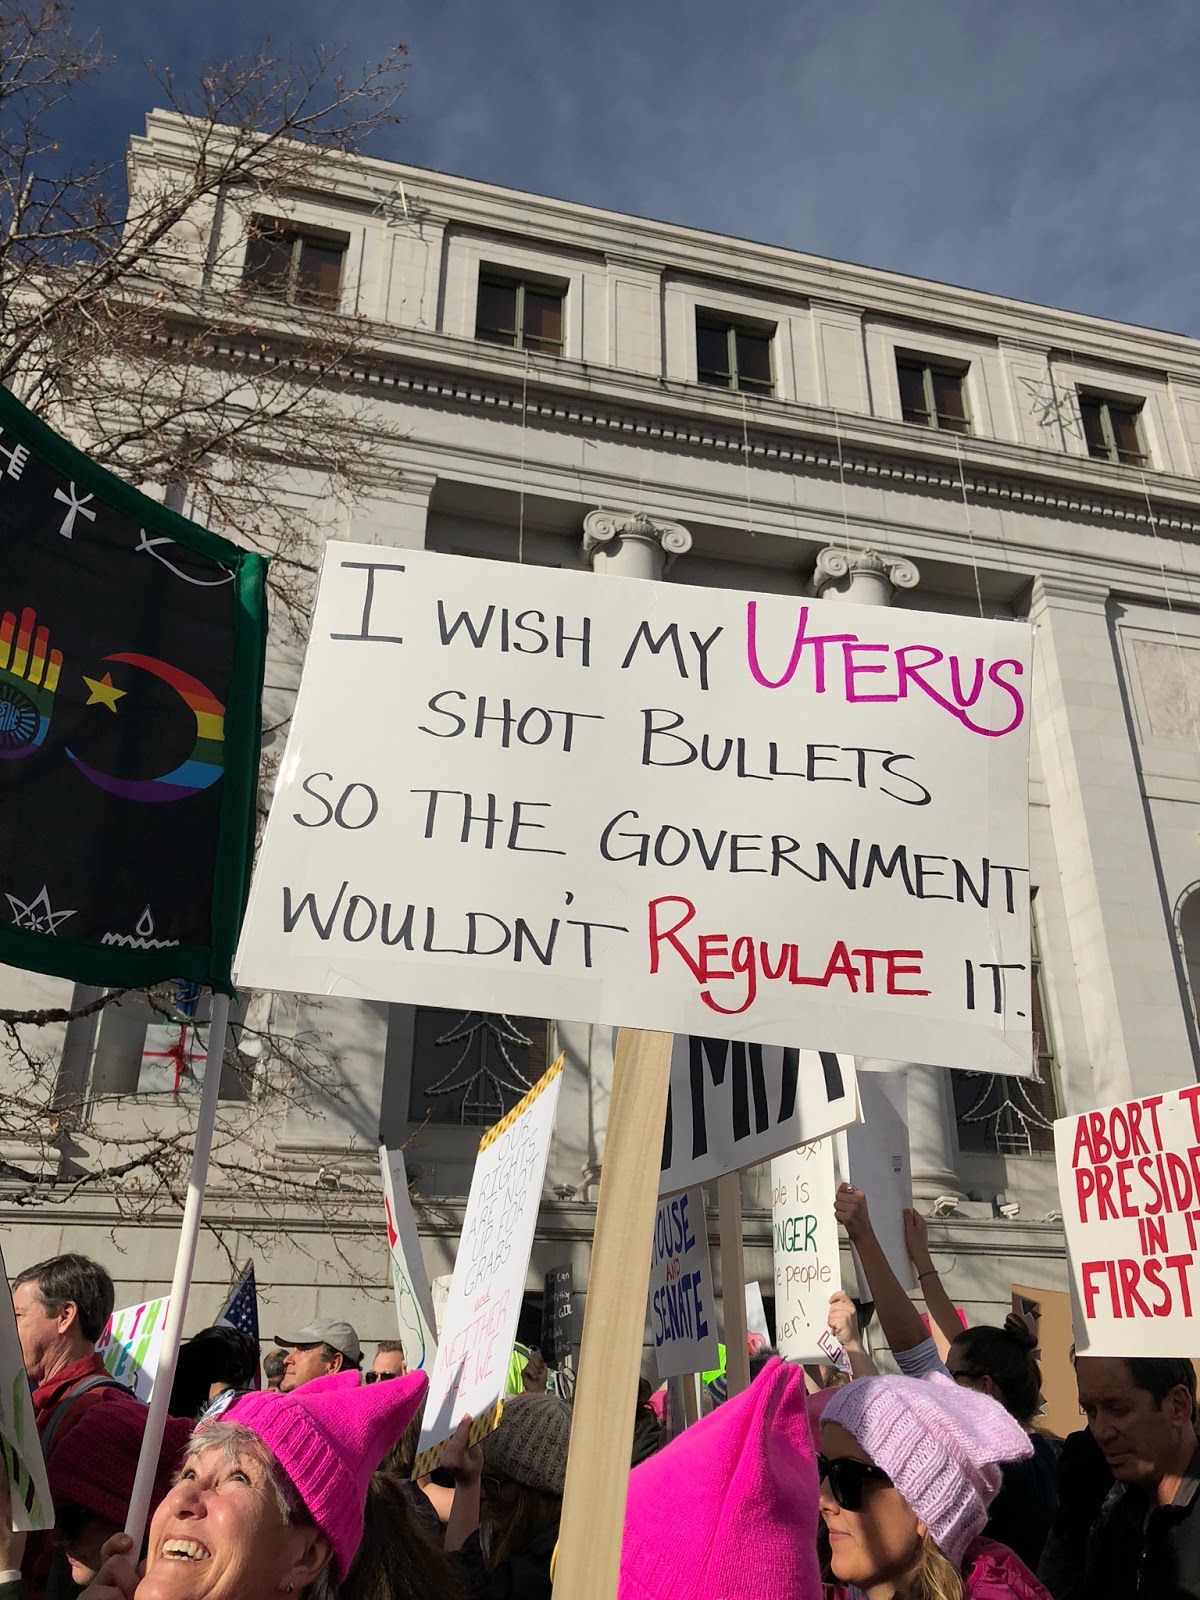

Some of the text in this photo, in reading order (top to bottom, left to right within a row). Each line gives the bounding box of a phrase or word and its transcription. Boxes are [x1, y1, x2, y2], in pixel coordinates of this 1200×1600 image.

[330, 561, 1025, 737] I WISH MY UTERUS
[418, 690, 932, 805] SHOT BULLETS
[293, 772, 1030, 914] SO THE GOVERNMENT
[283, 882, 629, 967] WOULDN'T
[964, 959, 1026, 1017] IT.
[498, 1110, 532, 1161] OUR
[1072, 1095, 1163, 1168] ABORT
[466, 1152, 540, 1245] ARE NOT
[478, 1128, 538, 1208] RIGHTS
[795, 1175, 810, 1203] is
[472, 1190, 527, 1262] UP FOR
[1137, 1215, 1169, 1256] IN
[464, 1232, 513, 1296] GRABS
[666, 1257, 681, 1283] AND
[786, 1257, 831, 1301] people
[1081, 1253, 1193, 1319] FIRST
[440, 1289, 510, 1374] NEITHER
[653, 1270, 709, 1347] SENATE
[475, 1332, 499, 1386] WE
